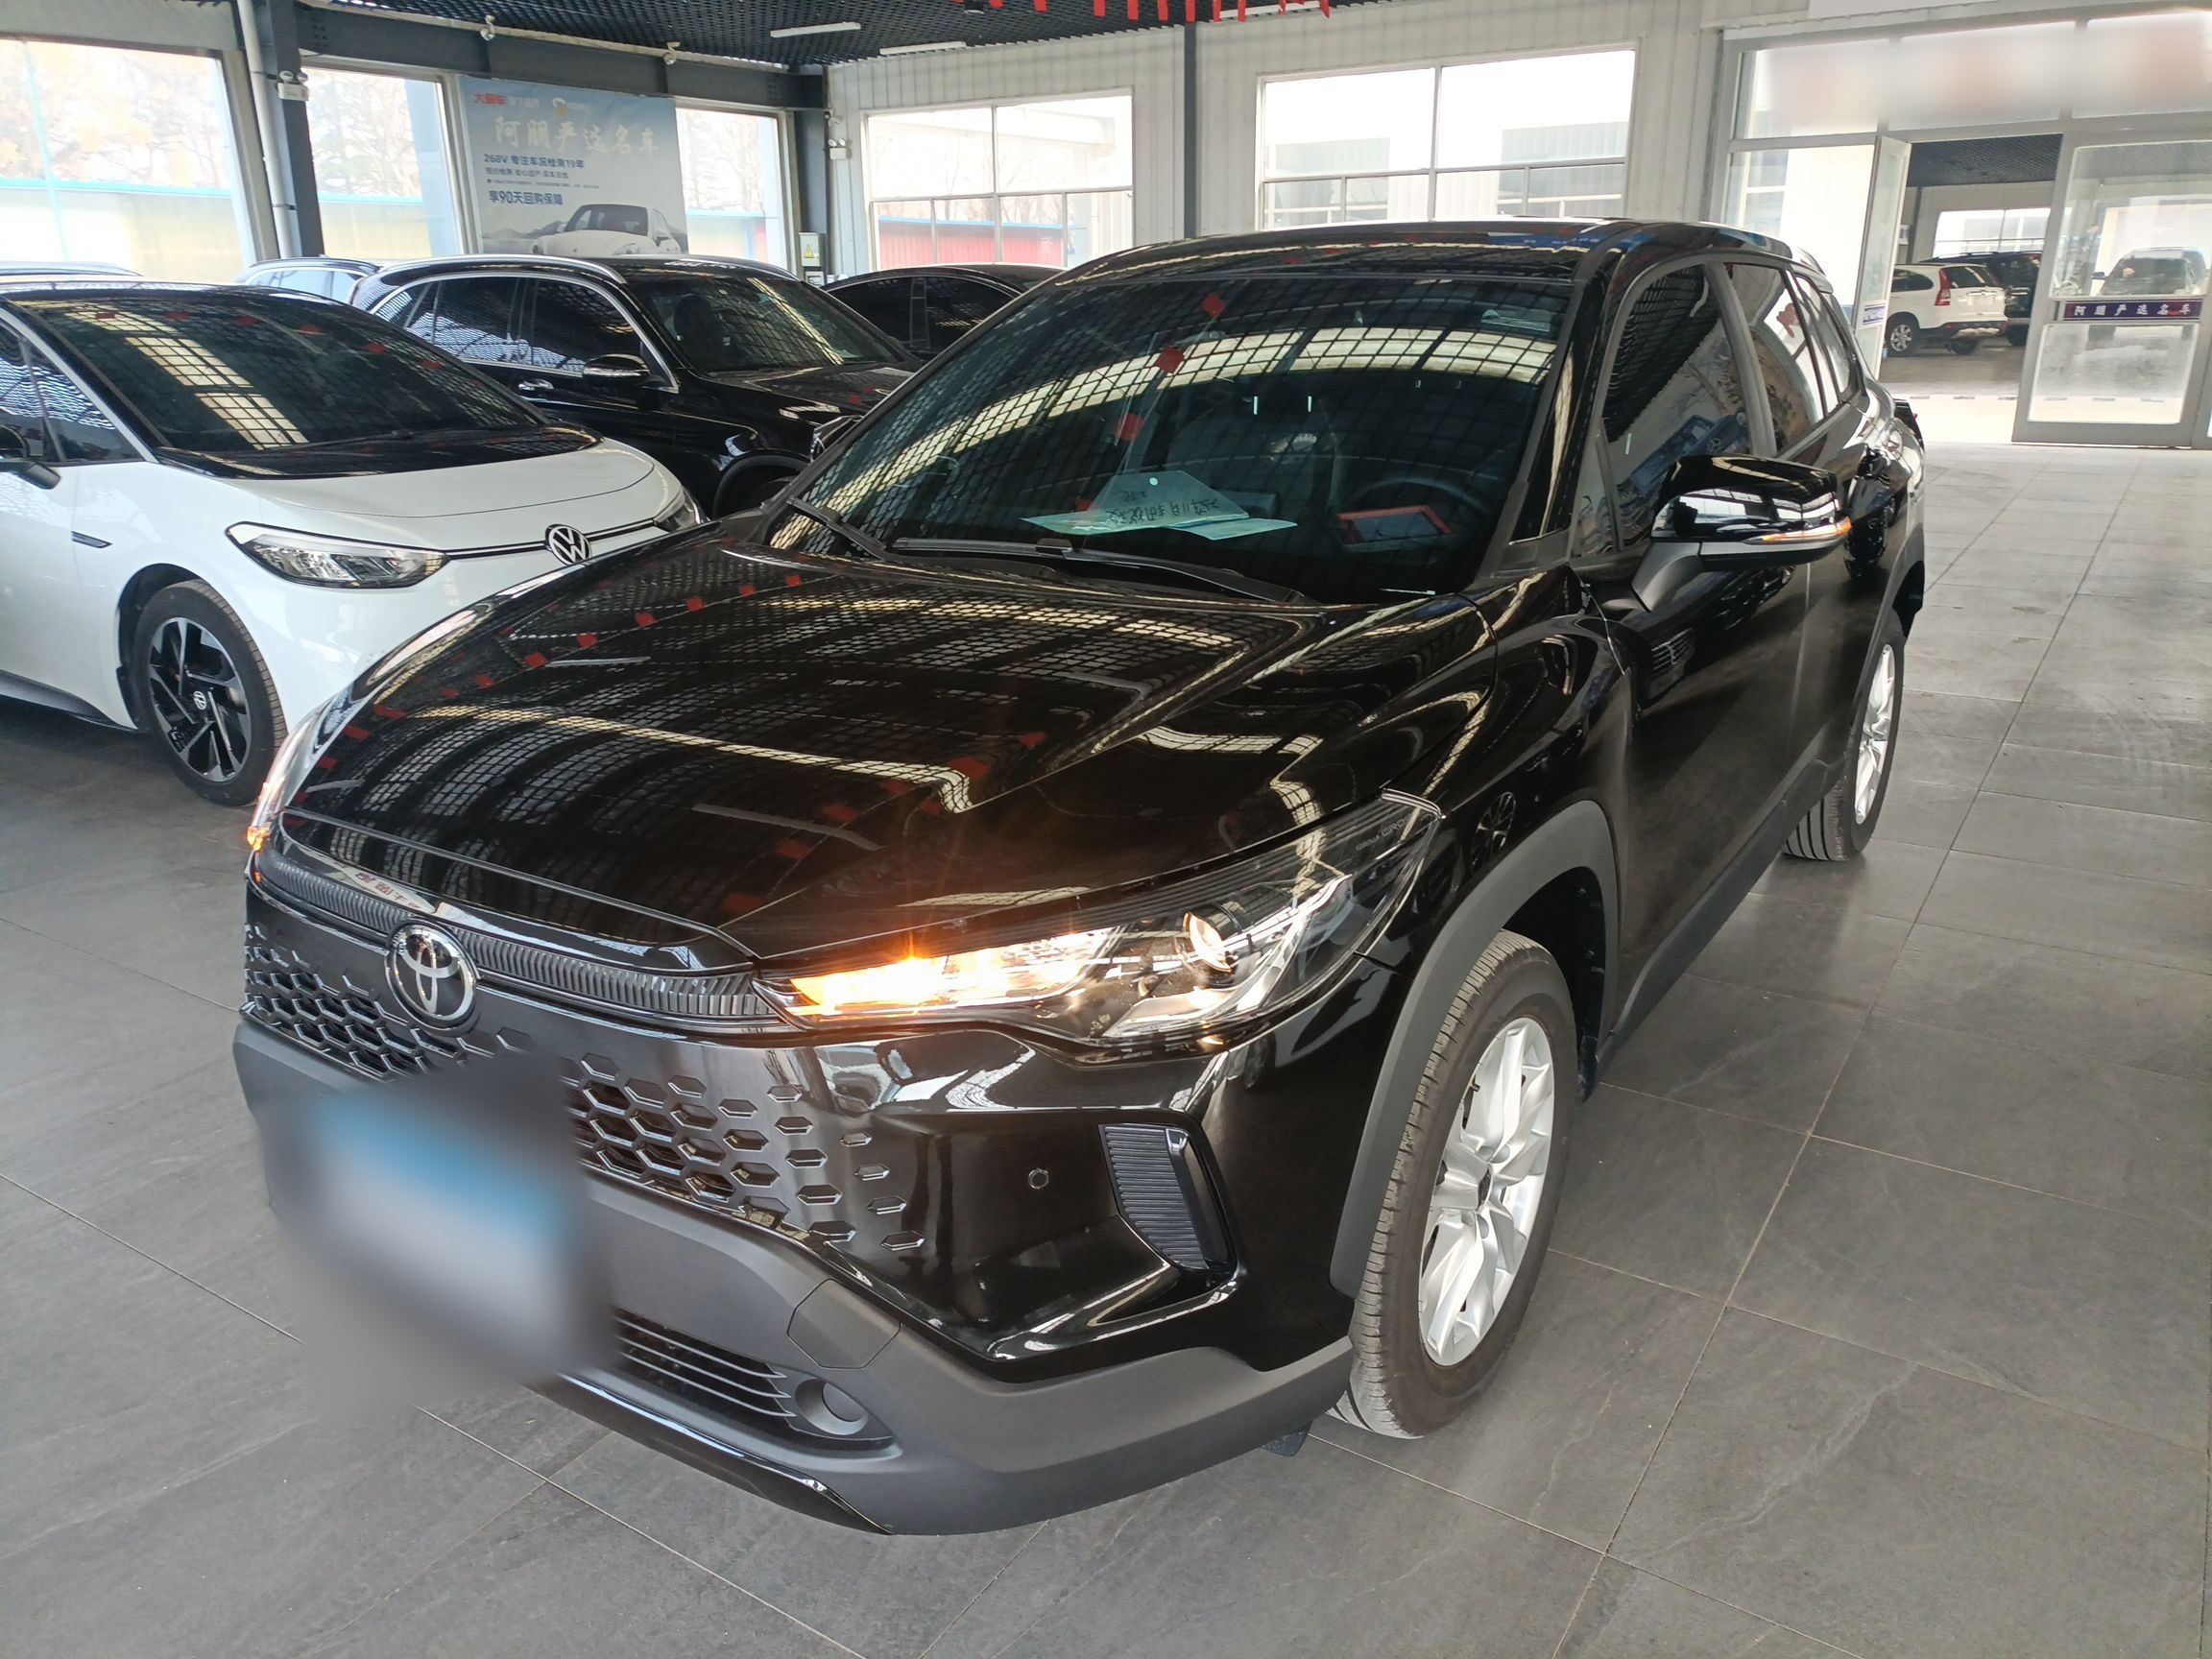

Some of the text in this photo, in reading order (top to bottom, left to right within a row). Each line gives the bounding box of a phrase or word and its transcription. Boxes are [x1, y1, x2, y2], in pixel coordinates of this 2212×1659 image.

[494, 116, 660, 158] 阿朋严选名车
[489, 190, 565, 206] 享90天回购保障
